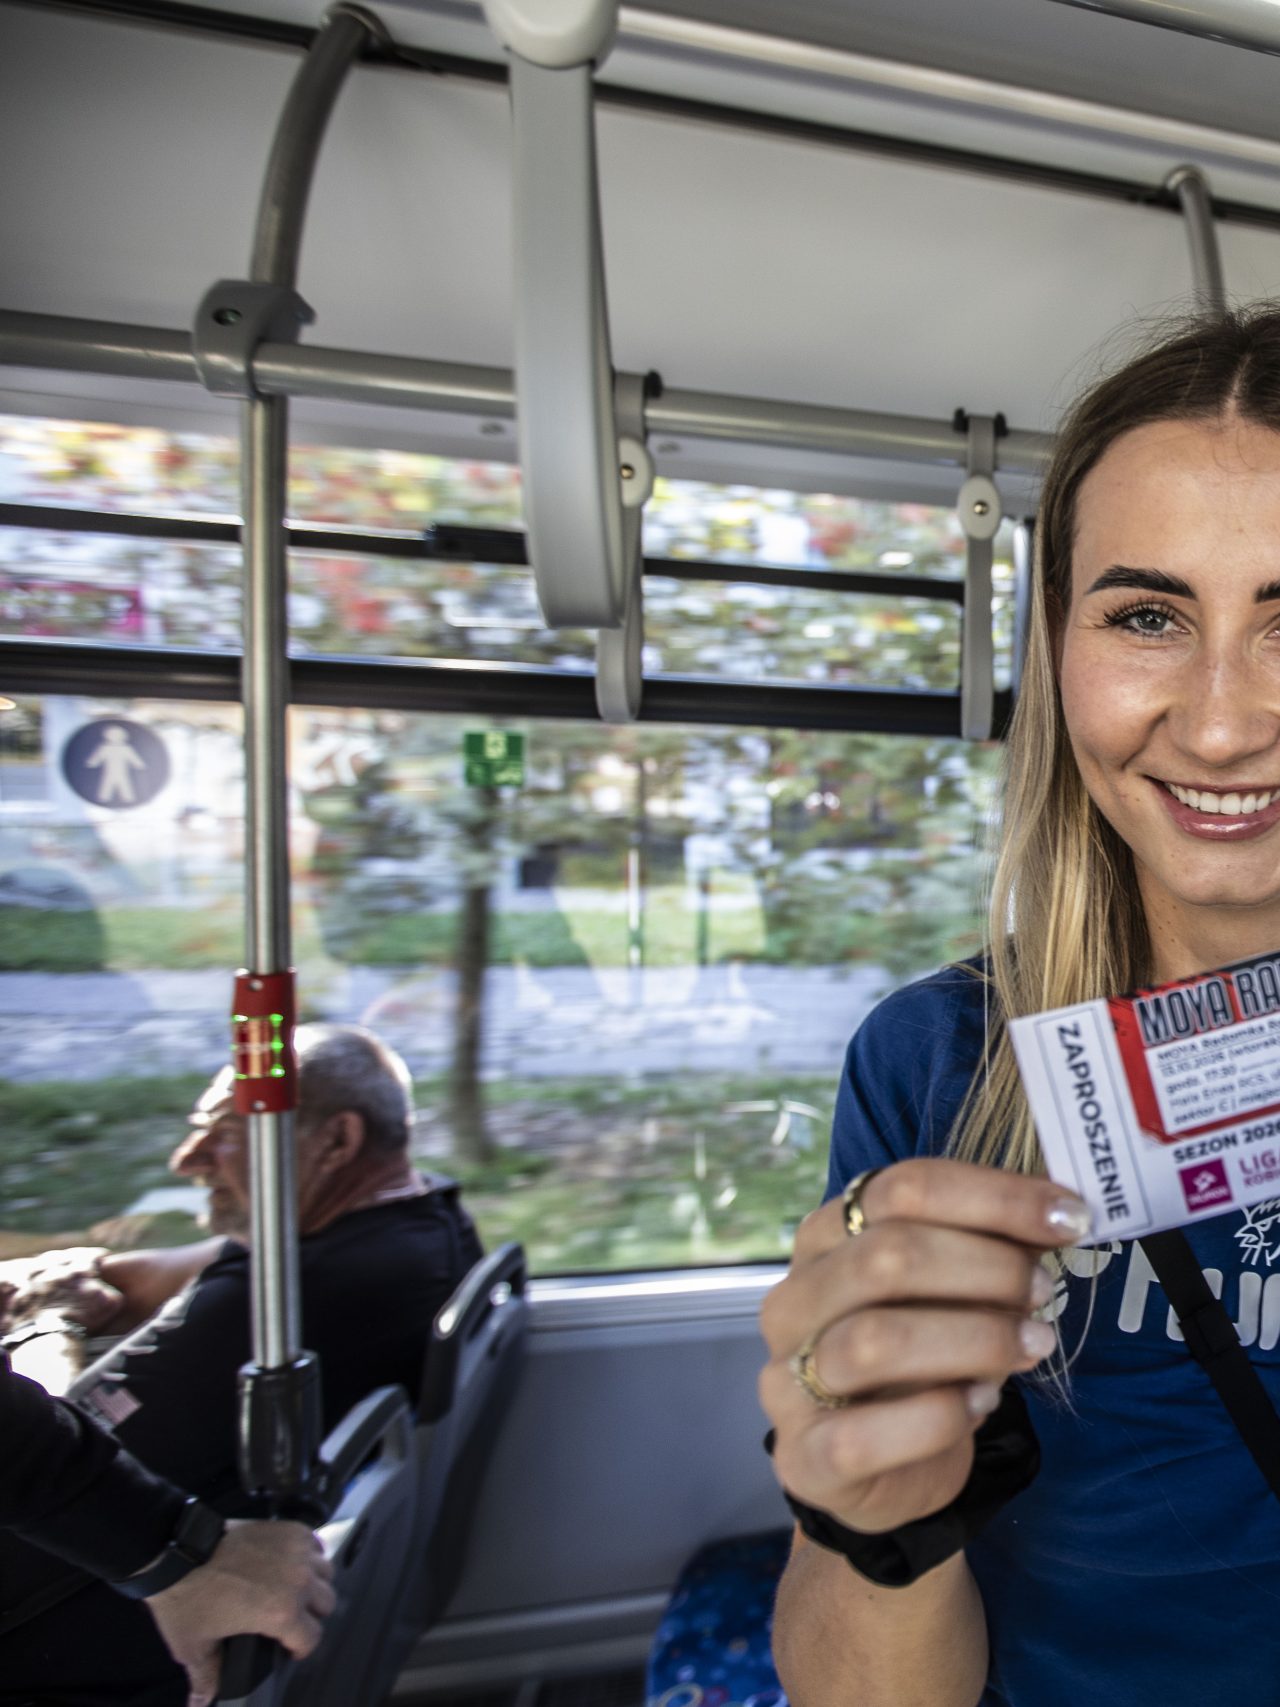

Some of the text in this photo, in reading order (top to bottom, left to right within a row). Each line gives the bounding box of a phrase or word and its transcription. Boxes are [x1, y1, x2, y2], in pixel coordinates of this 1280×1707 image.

[1134, 977, 1234, 1048] MOYA
[1202, 1024, 1265, 1047] Radomka
[1057, 1020, 1130, 1223] ZAPROSZENIE
[1172, 1133, 1238, 1163] SEZON
